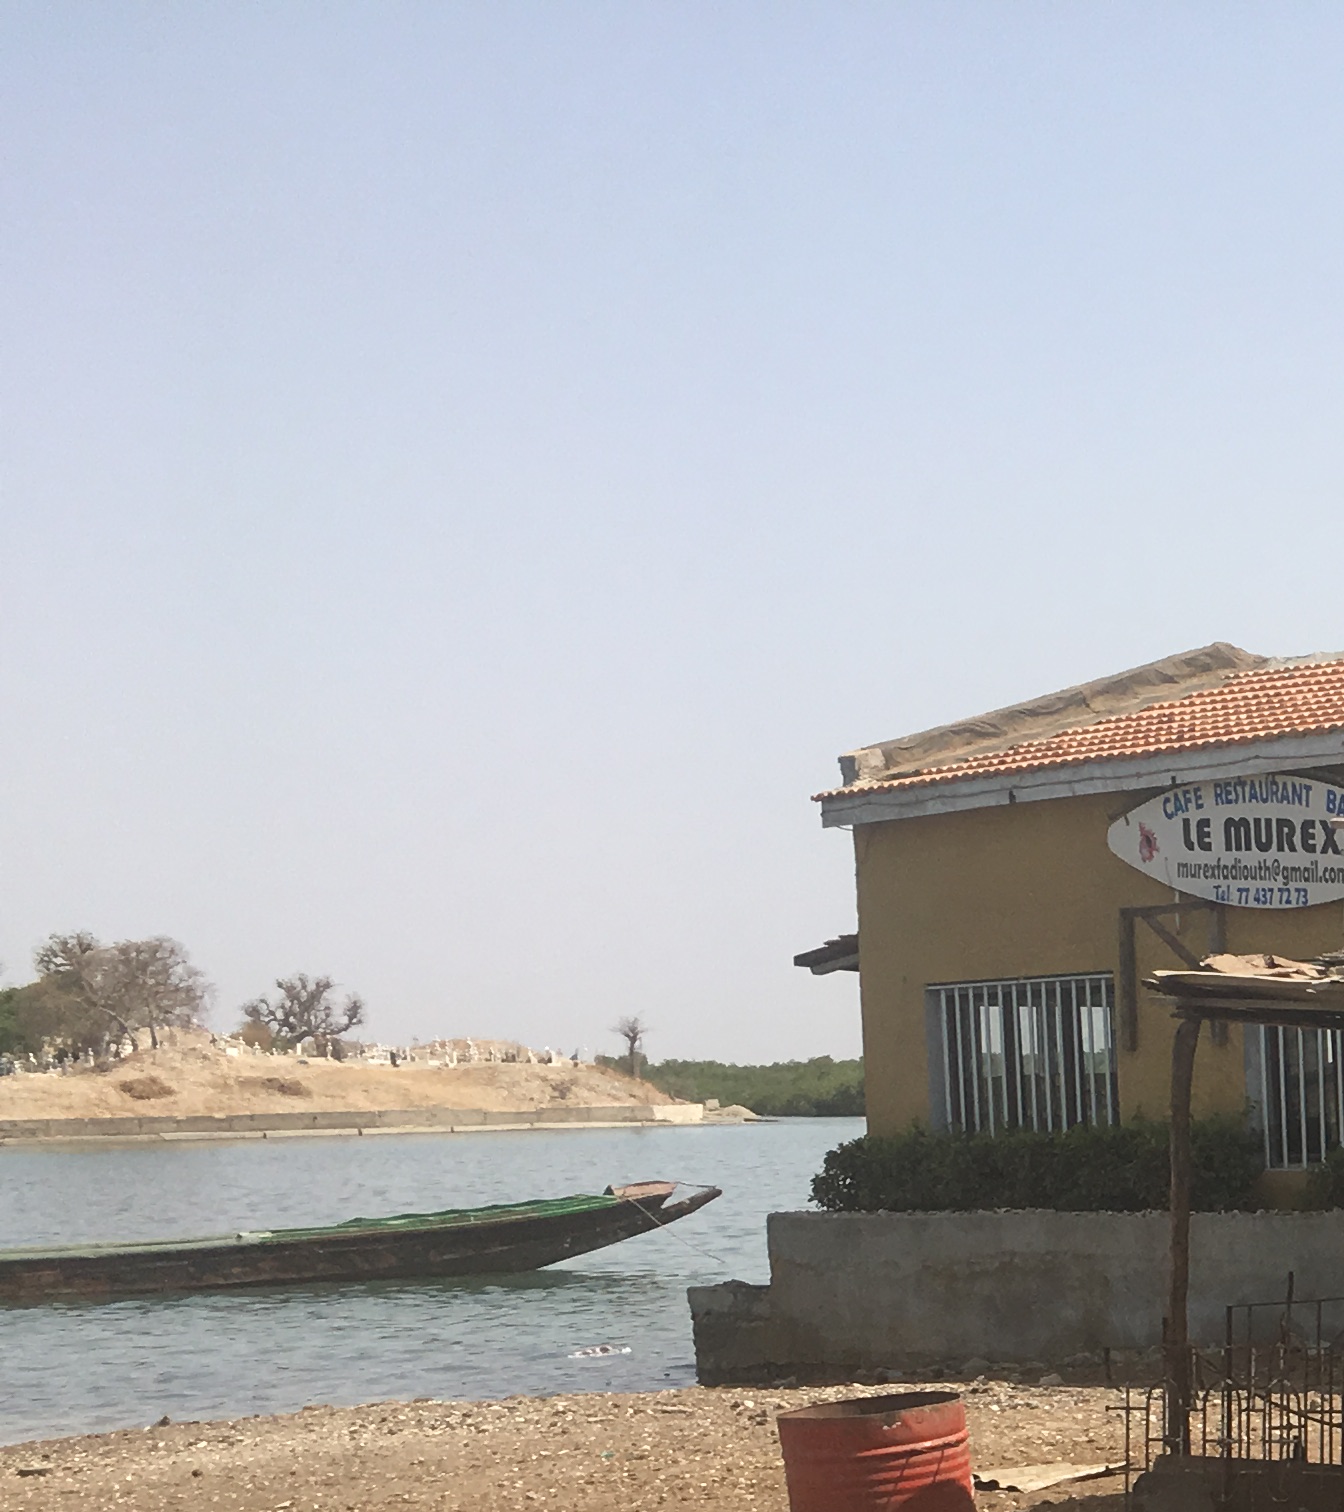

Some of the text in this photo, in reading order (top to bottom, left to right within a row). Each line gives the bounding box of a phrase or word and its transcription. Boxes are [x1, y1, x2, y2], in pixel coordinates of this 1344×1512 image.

[1163, 787, 1204, 820] CAFE
[1214, 775, 1312, 808] RESTAURANT
[1182, 817, 1341, 854] LE MUREX
[1237, 888, 1250, 905] 77
[1254, 888, 1274, 905] 437
[1278, 887, 1292, 905] 72
[1295, 888, 1308, 906] 73
